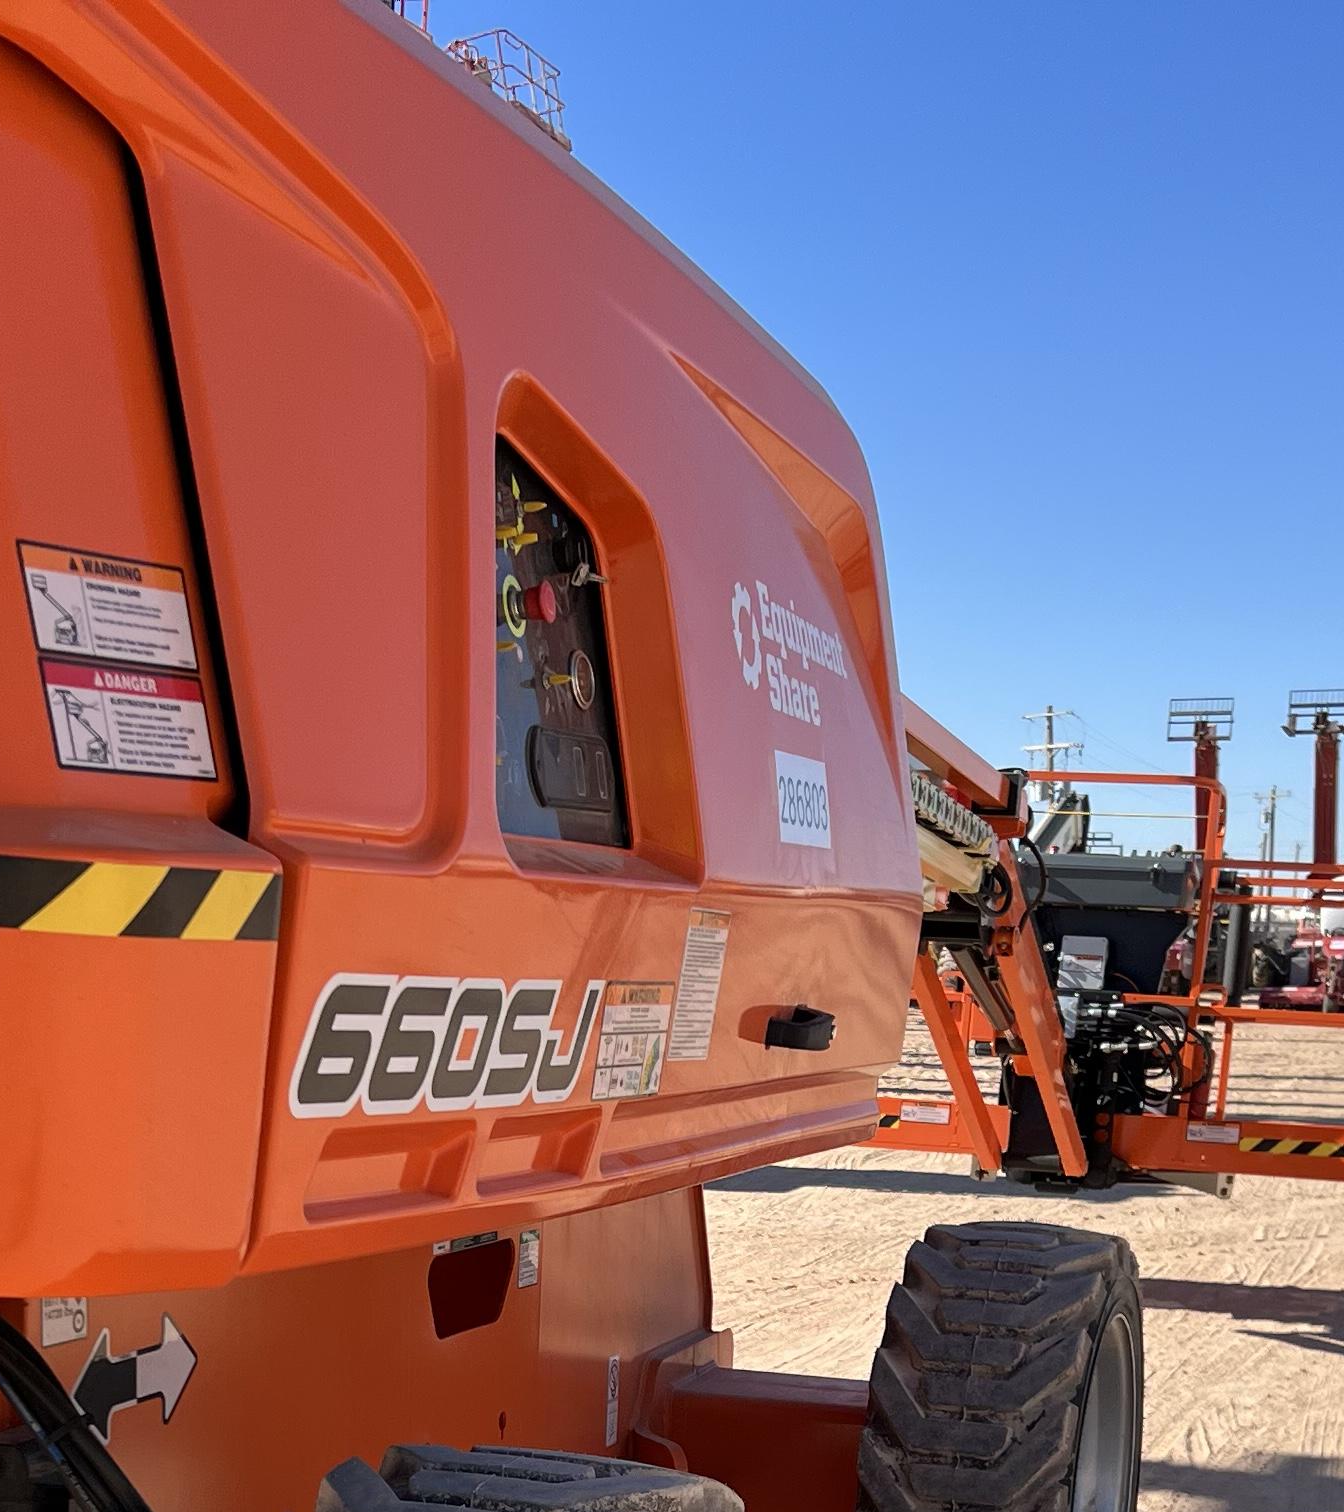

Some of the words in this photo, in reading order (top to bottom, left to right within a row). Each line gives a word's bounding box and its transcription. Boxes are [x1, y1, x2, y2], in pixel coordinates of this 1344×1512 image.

[82, 558, 143, 582] WARNING
[756, 579, 848, 680] Equipment
[105, 671, 158, 693] DANGER
[766, 653, 822, 727] Share
[778, 775, 829, 831] 286803
[289, 973, 605, 1118] 660SJ
